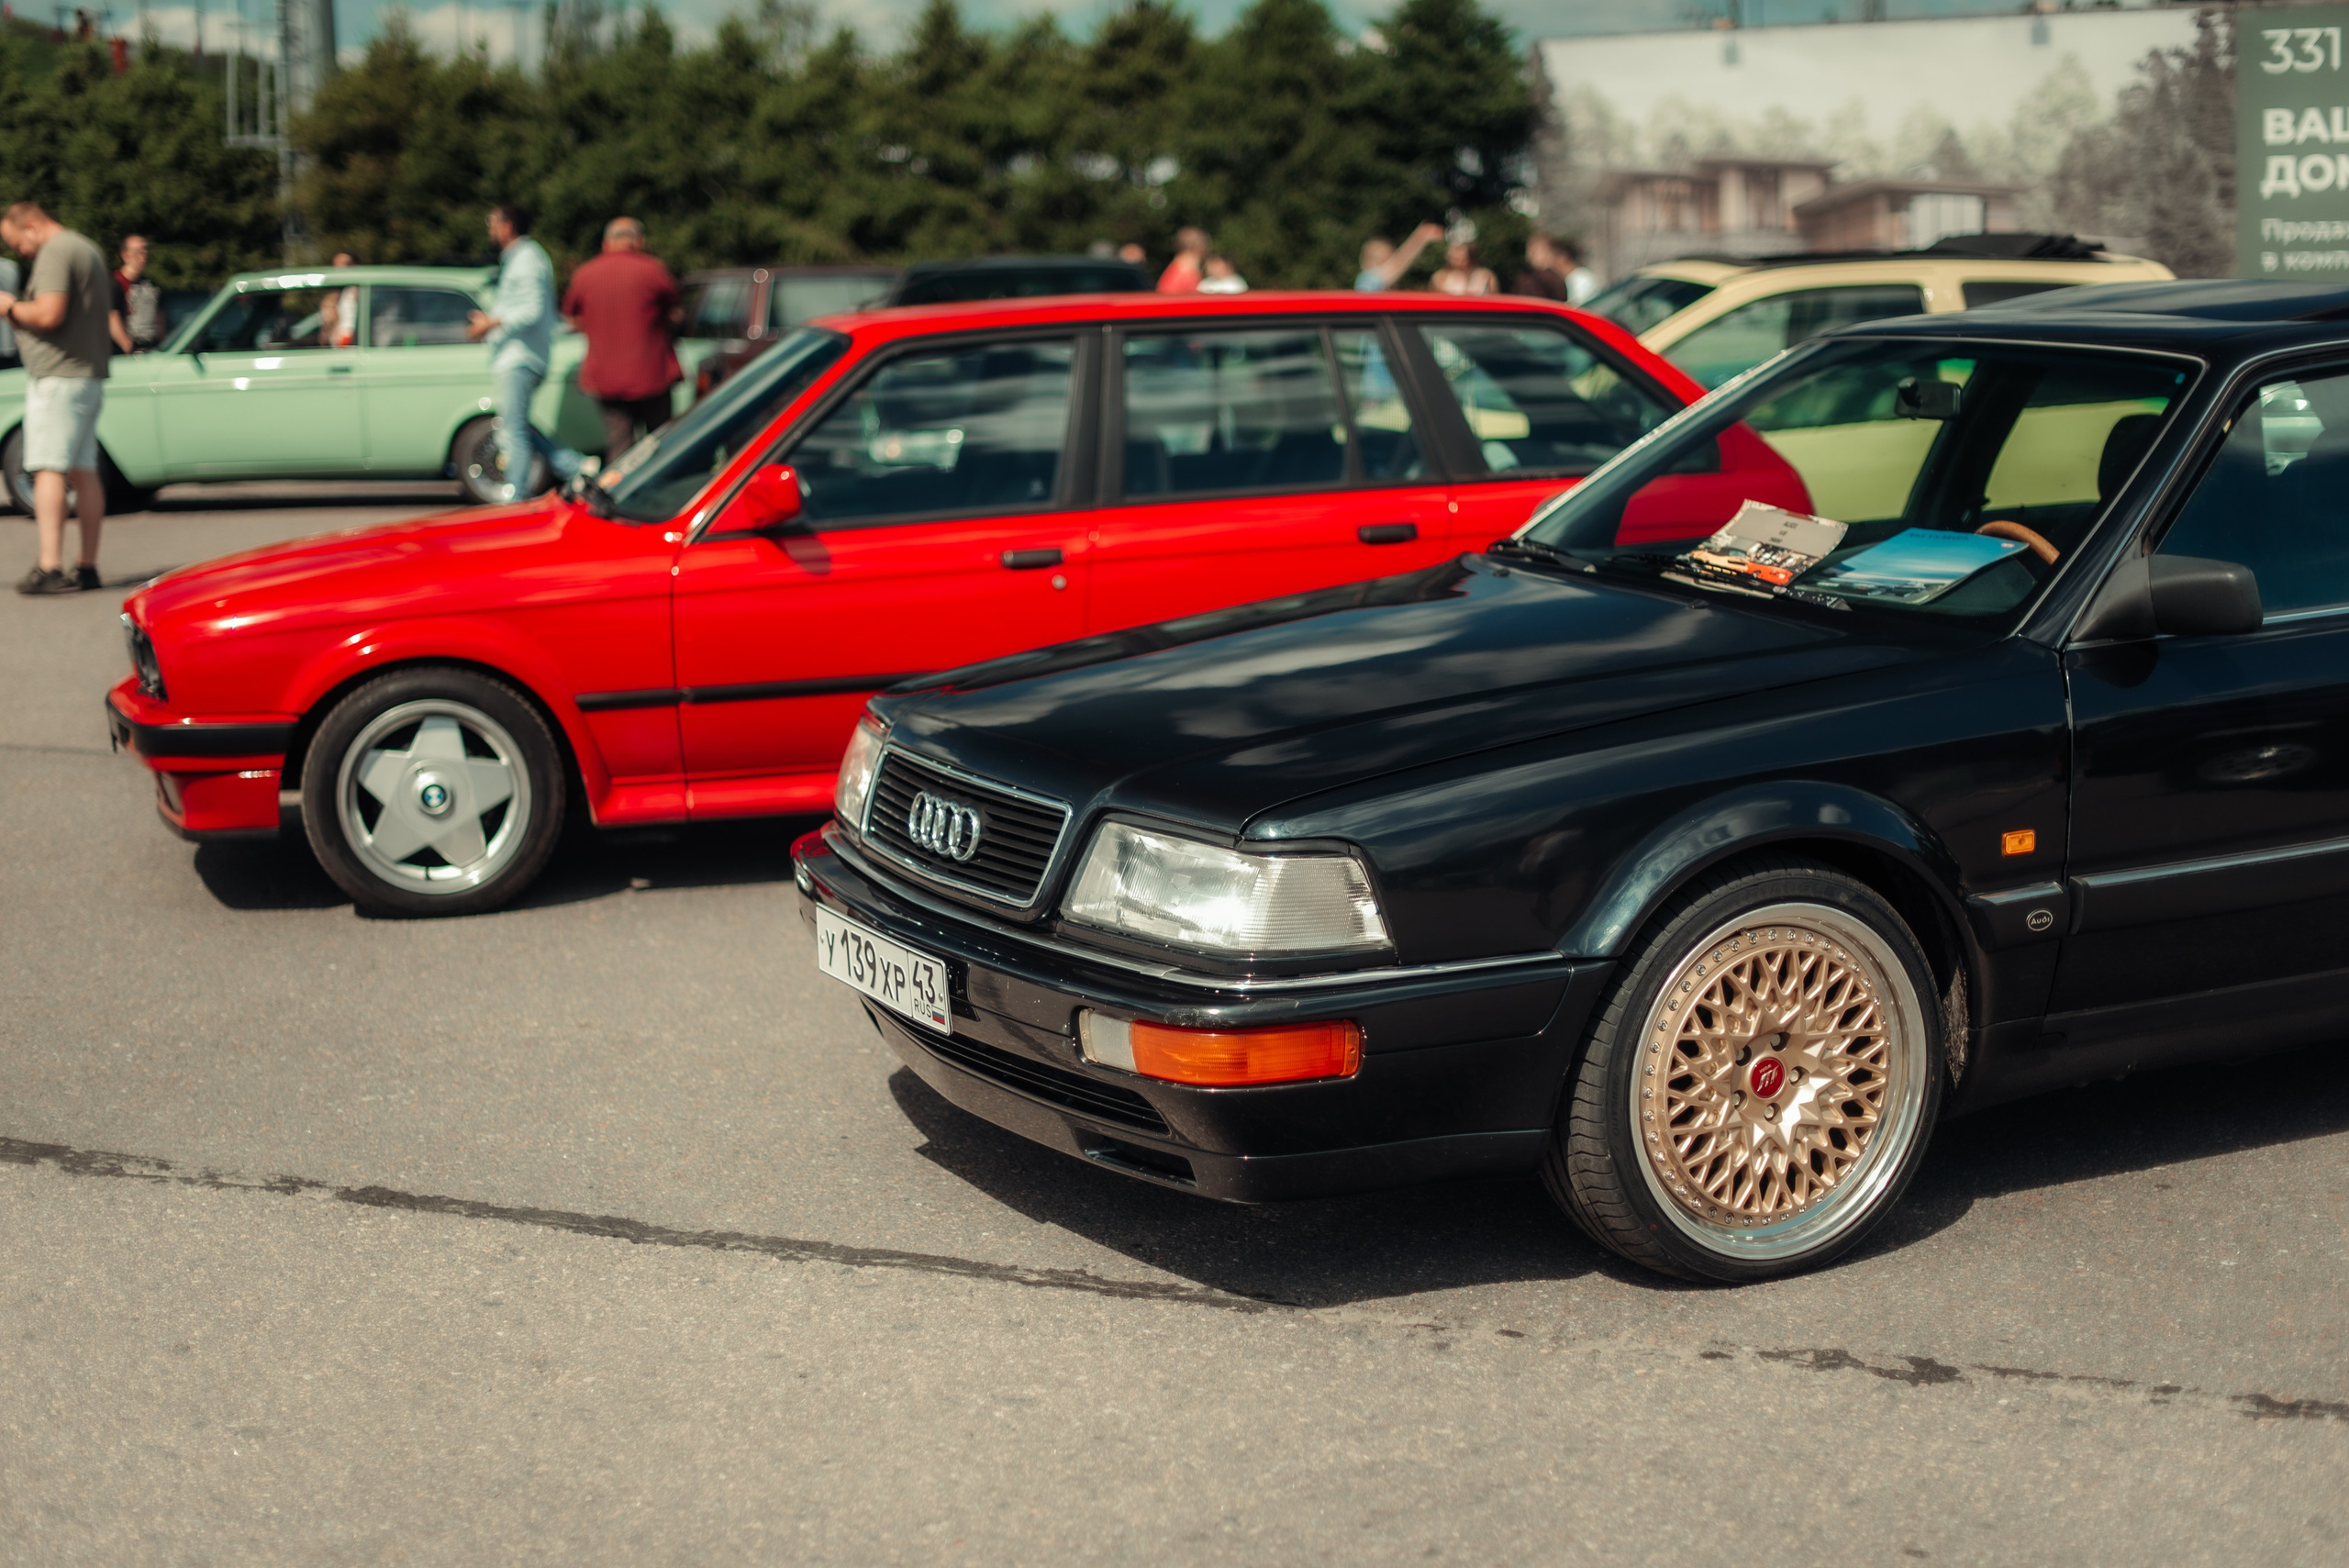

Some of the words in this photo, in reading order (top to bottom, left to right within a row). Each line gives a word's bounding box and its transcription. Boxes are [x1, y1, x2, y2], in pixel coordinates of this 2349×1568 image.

[2260, 27, 2342, 74] 331
[2031, 916, 2050, 925] Audi
[913, 960, 936, 1005] 43
[914, 998, 932, 1018] RUS
